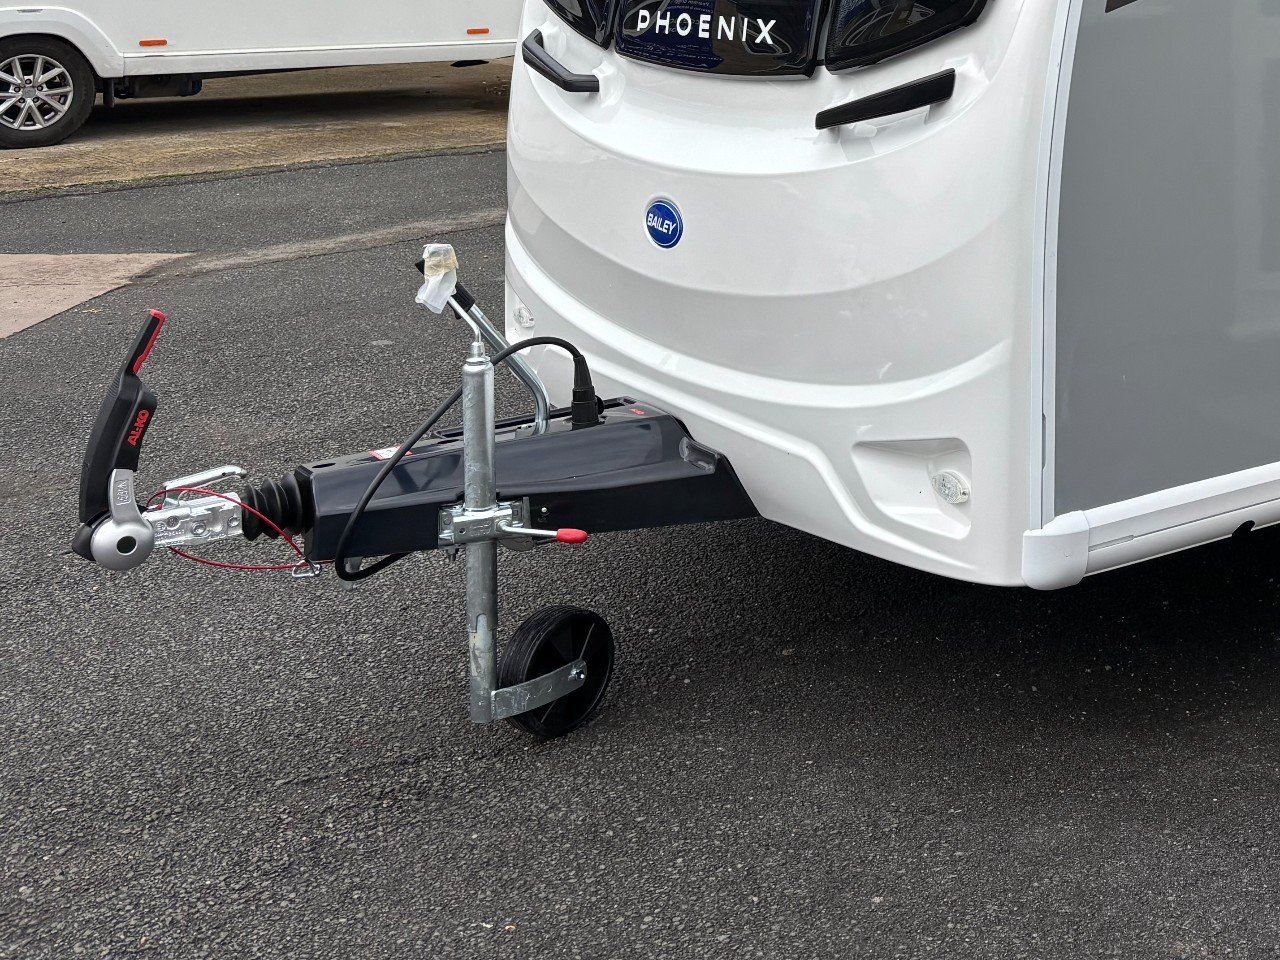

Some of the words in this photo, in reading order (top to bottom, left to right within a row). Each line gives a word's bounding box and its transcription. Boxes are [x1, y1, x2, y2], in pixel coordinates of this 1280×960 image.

[636, 9, 777, 46] PHOENIX
[647, 213, 677, 235] BAILEY
[127, 409, 150, 447] AL-KO
